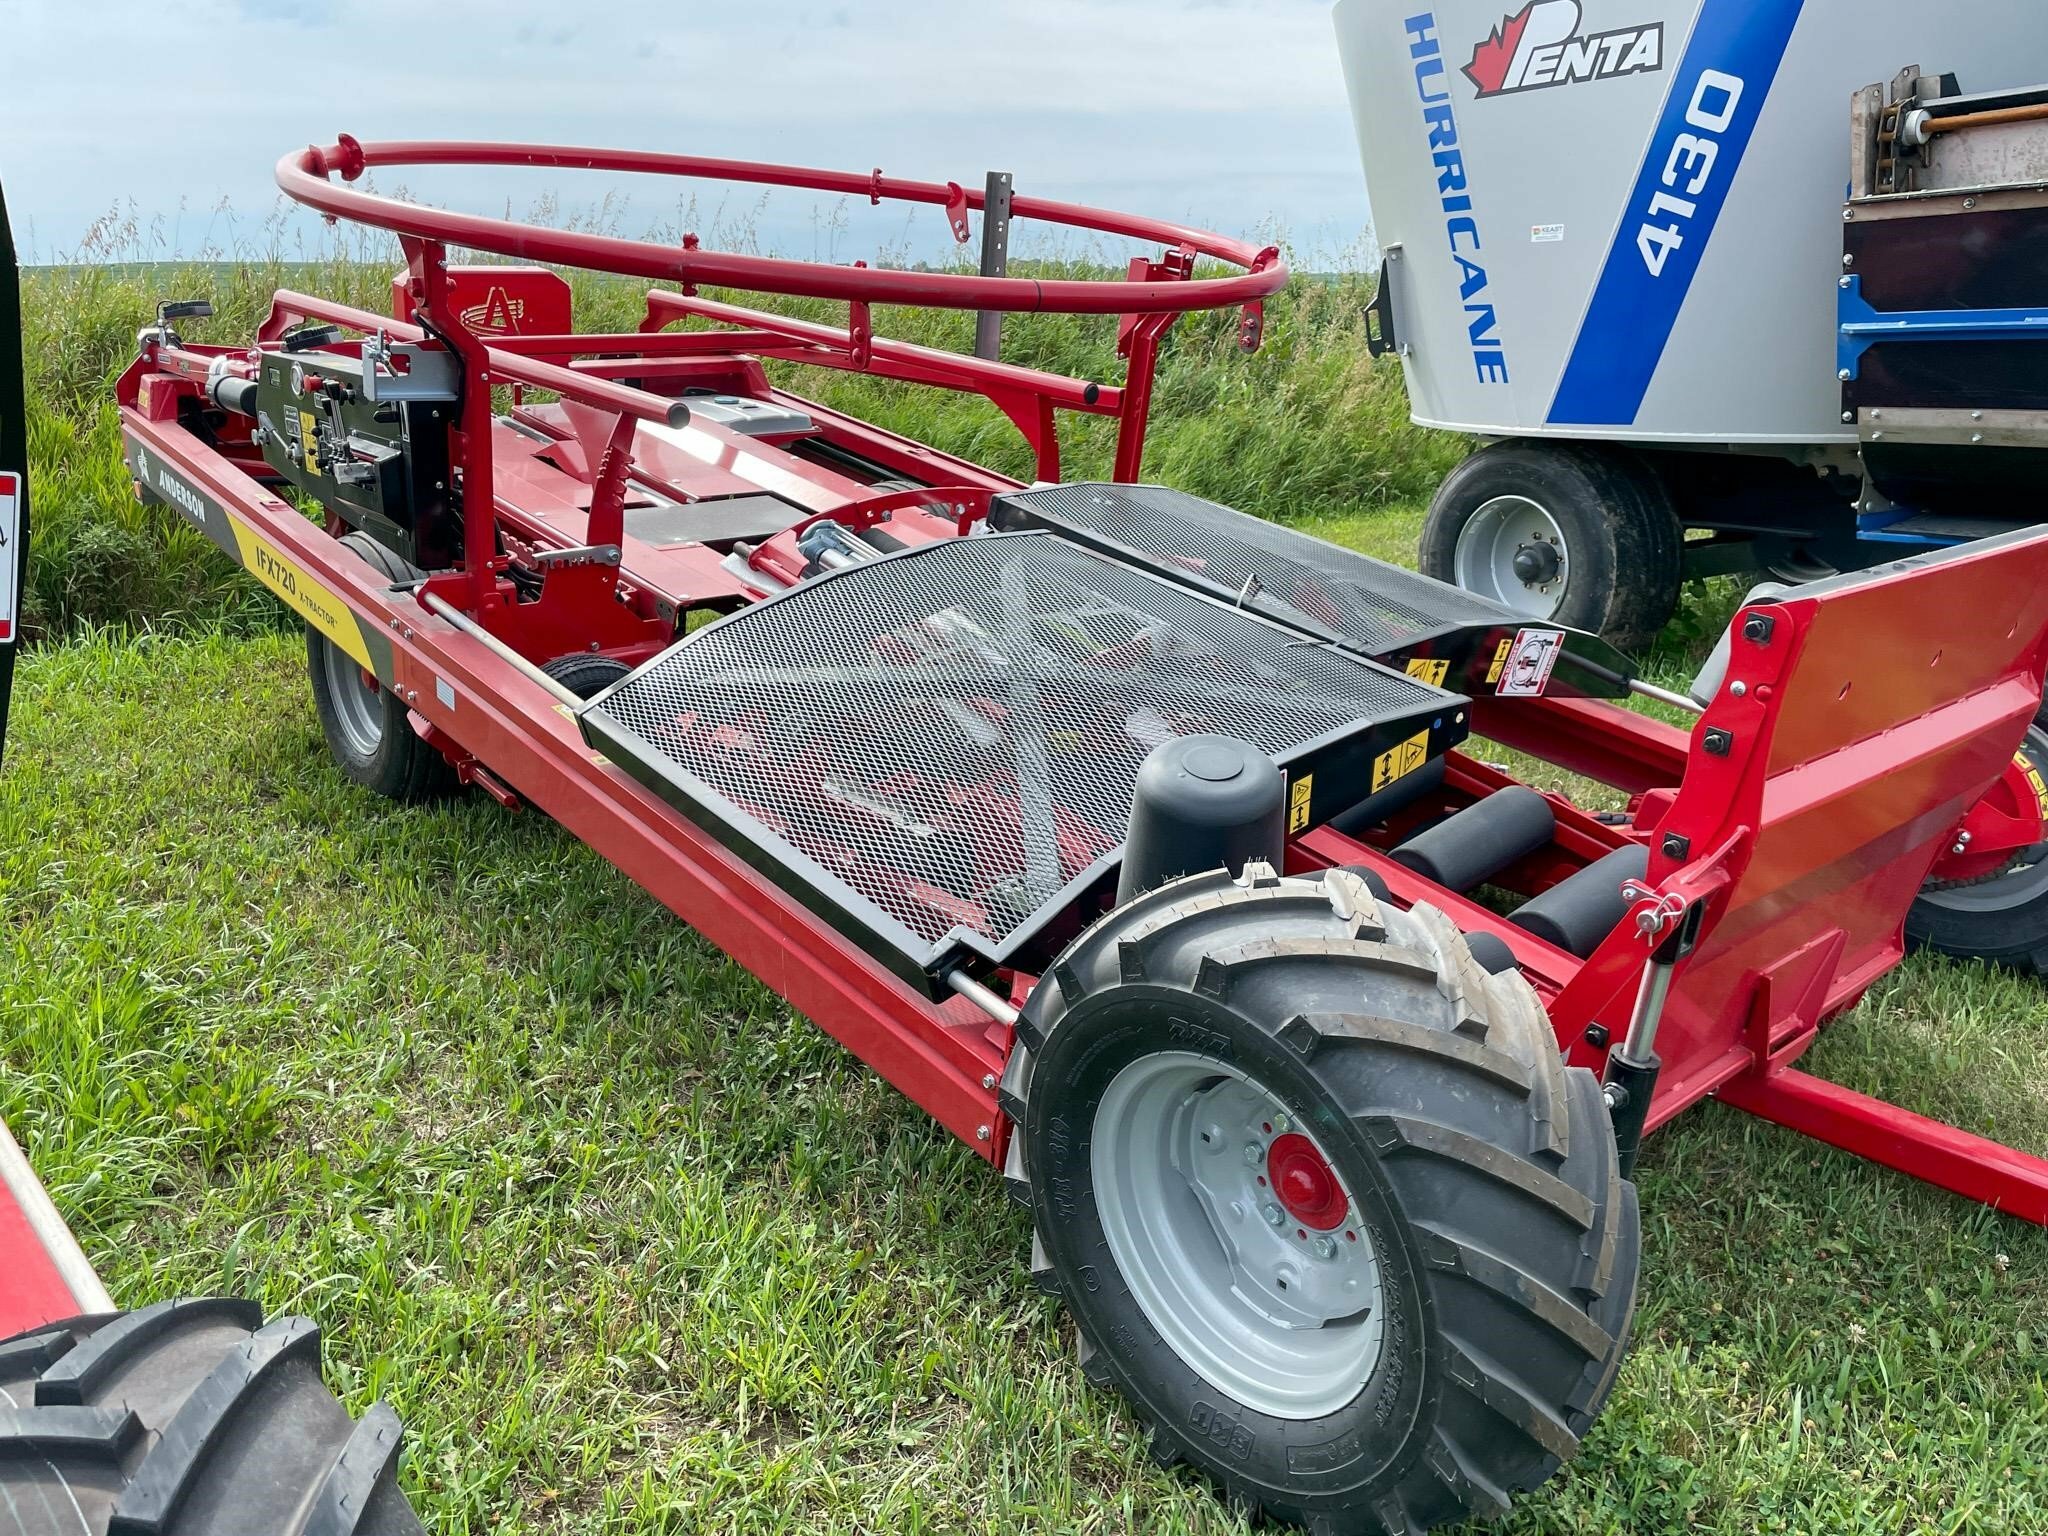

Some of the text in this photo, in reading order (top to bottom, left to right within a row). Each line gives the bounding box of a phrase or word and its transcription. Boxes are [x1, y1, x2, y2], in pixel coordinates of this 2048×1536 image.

[1501, 0, 1661, 91] PENTA
[1404, 12, 1510, 385] HURRICANE
[1636, 68, 1745, 278] 4130
[159, 469, 206, 523] ANDERSON
[256, 546, 296, 596] IFX720
